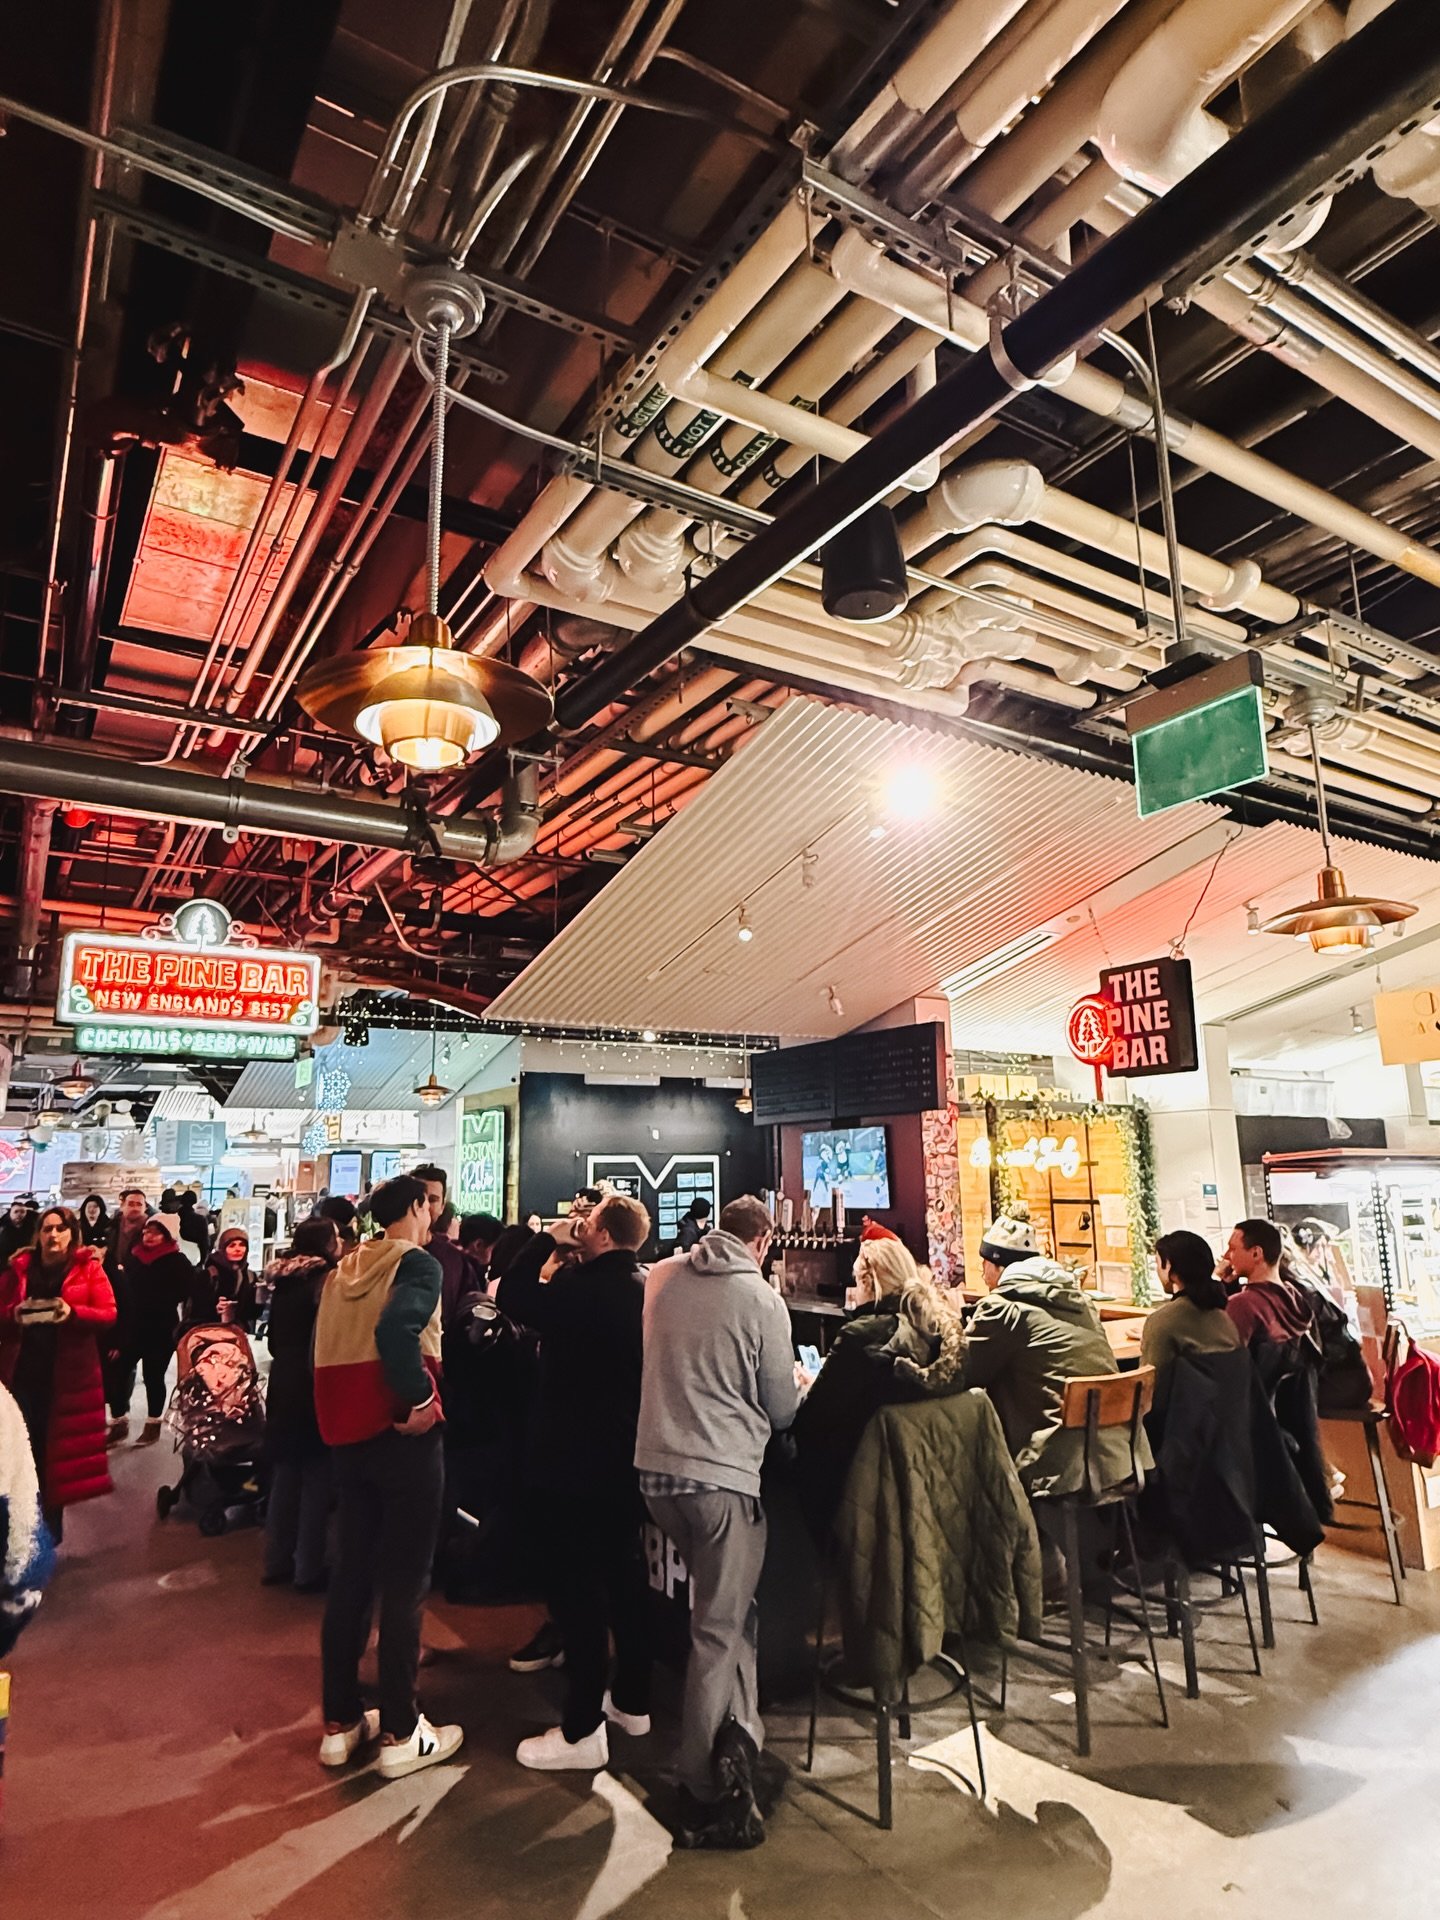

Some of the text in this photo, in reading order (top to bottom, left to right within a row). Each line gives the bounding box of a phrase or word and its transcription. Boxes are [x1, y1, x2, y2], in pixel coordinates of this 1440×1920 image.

[631, 408, 653, 426] HOT
[682, 418, 708, 444] HOT
[736, 438, 770, 468] COLD
[82, 949, 308, 994] THE PINE BAR
[1108, 966, 1161, 1003] THE
[95, 990, 292, 1020] NEW ENGLAND'S BEST
[1105, 999, 1171, 1037] PINE
[80, 1026, 296, 1056] COCKTAILS BEER WINE
[1112, 1035, 1169, 1070] BAR
[462, 1142, 495, 1161] BOSTON
